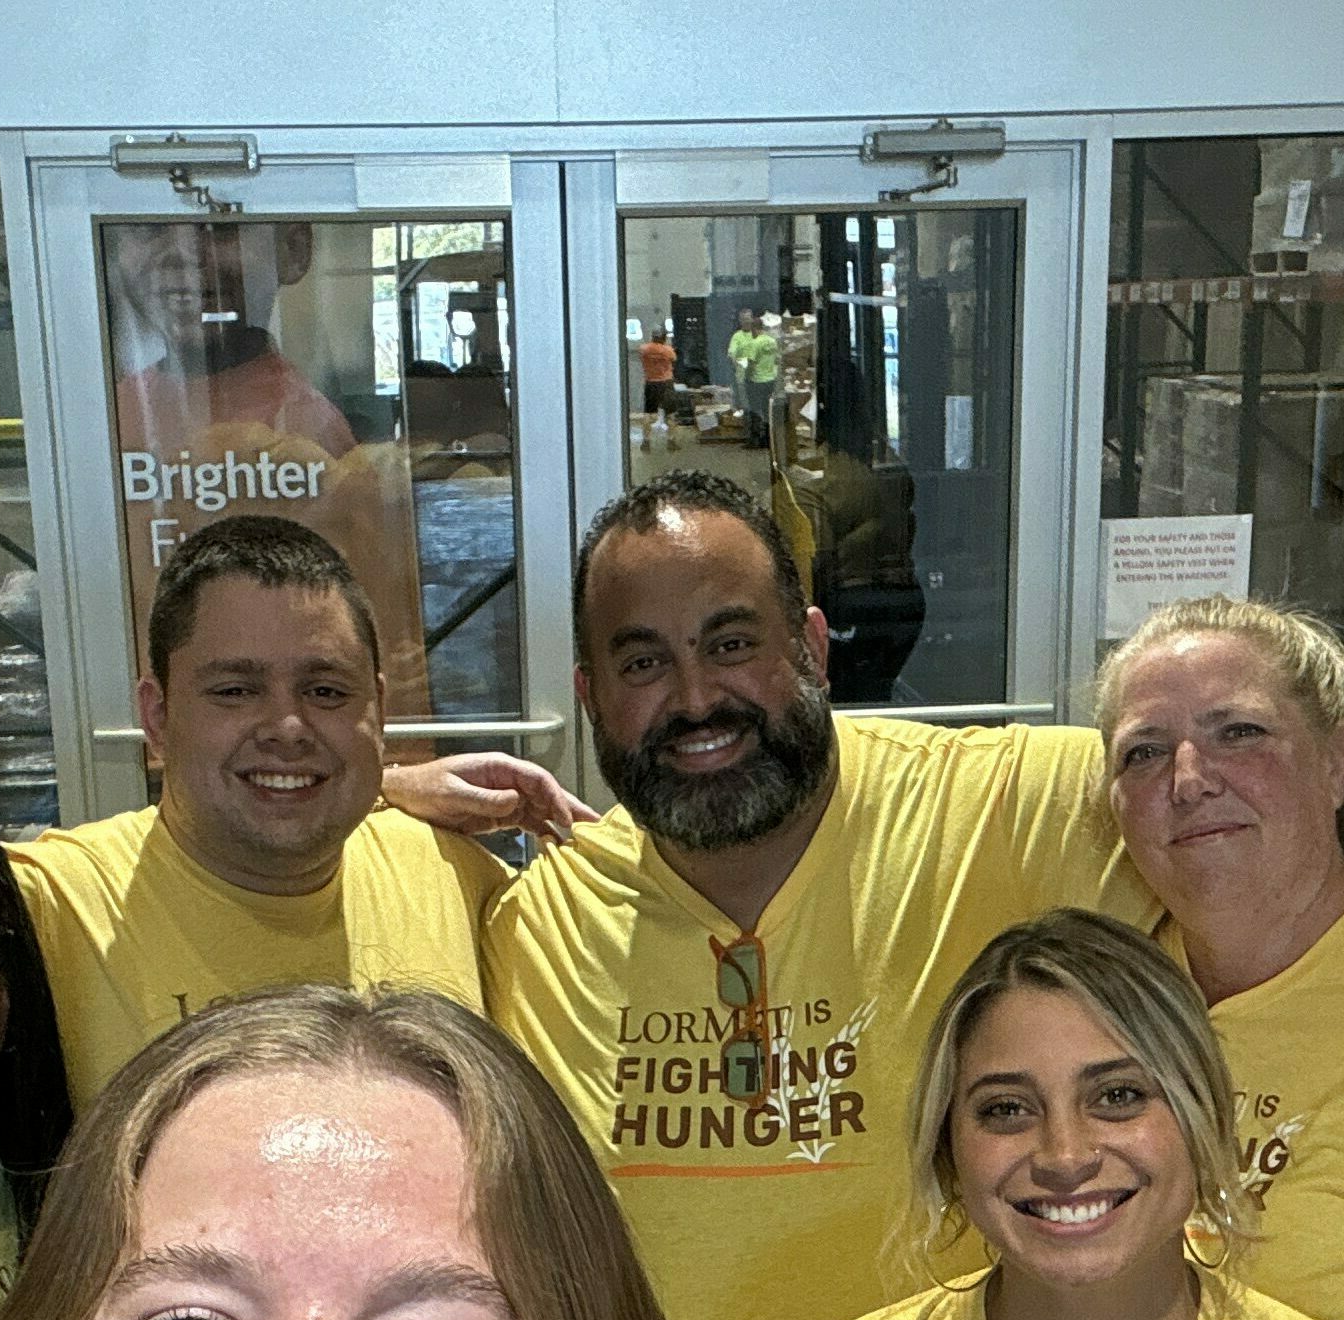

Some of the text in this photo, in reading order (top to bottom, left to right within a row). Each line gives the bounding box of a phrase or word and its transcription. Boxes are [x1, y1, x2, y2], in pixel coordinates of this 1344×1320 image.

[121, 450, 326, 511] Brighter
[805, 998, 832, 1026] IS
[615, 1041, 858, 1095] FIGHTING
[611, 1091, 867, 1149] HUNGER
